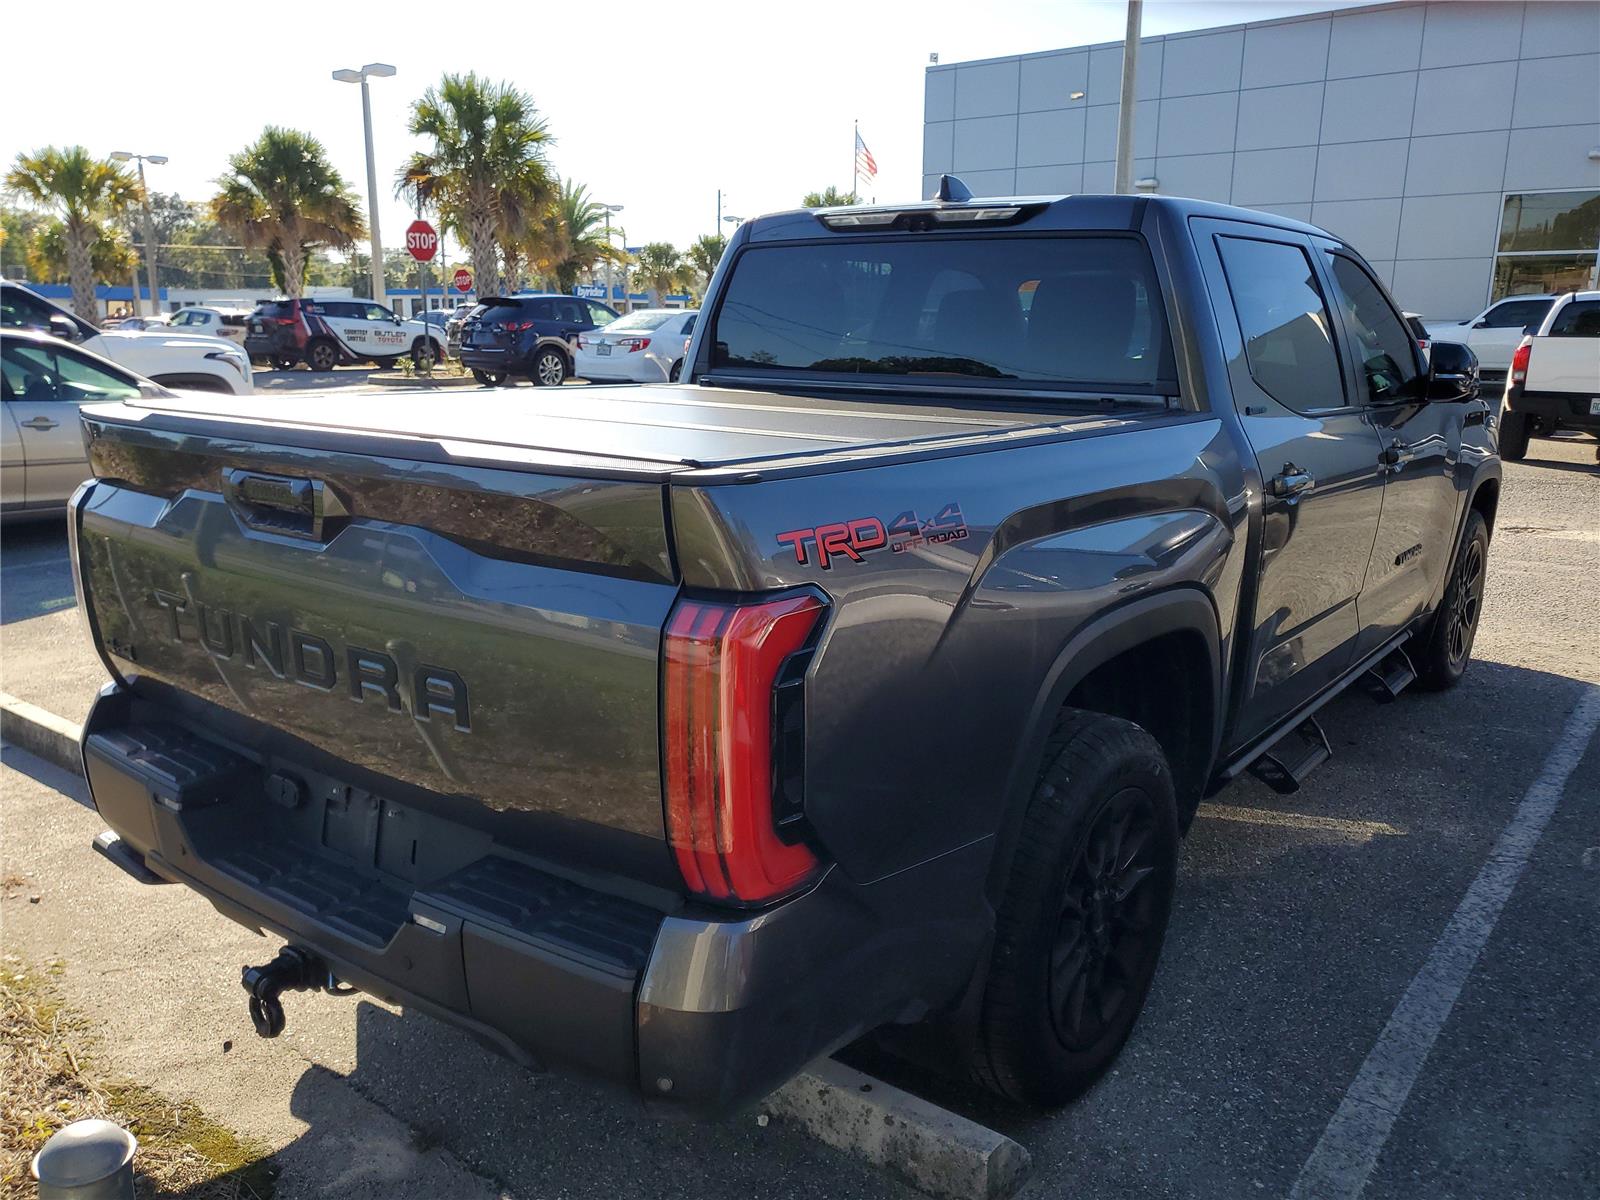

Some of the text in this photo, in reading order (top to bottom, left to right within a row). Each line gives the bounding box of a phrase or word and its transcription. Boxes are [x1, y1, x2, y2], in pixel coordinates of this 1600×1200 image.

[407, 232, 436, 250] STOP
[456, 275, 471, 286] STOP
[776, 517, 887, 569] TRD
[892, 528, 969, 554] OFF ROAD
[151, 589, 473, 733] TUNDRA
